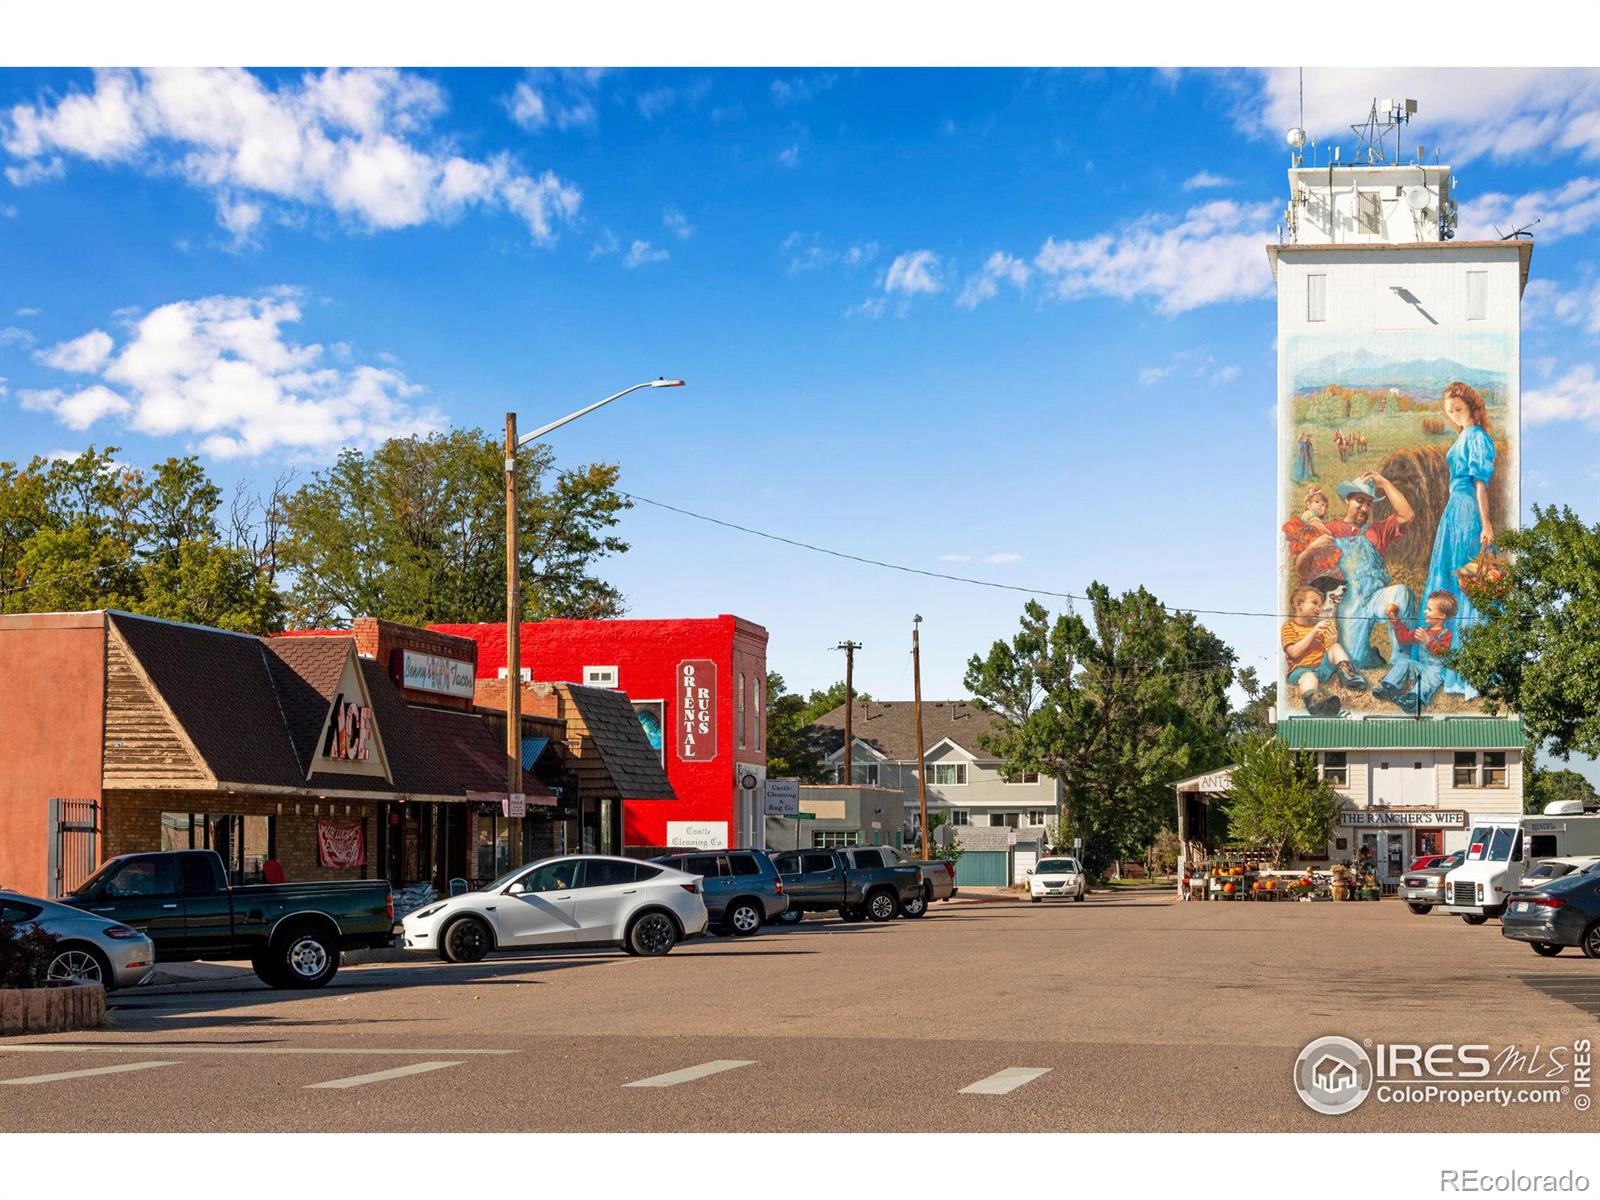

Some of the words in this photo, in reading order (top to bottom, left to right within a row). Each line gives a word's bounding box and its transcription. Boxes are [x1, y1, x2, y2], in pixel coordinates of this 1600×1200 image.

[450, 663, 472, 688] Tacos
[683, 665, 696, 757] ORIENTAL
[697, 687, 710, 734] RUGS
[322, 693, 371, 760] ACE
[766, 791, 796, 799] Cleaning
[1343, 813, 1363, 823] THE
[1367, 812, 1432, 823] RANCHER'S
[1435, 813, 1463, 823] WIFE
[672, 837, 708, 848] Cleaning
